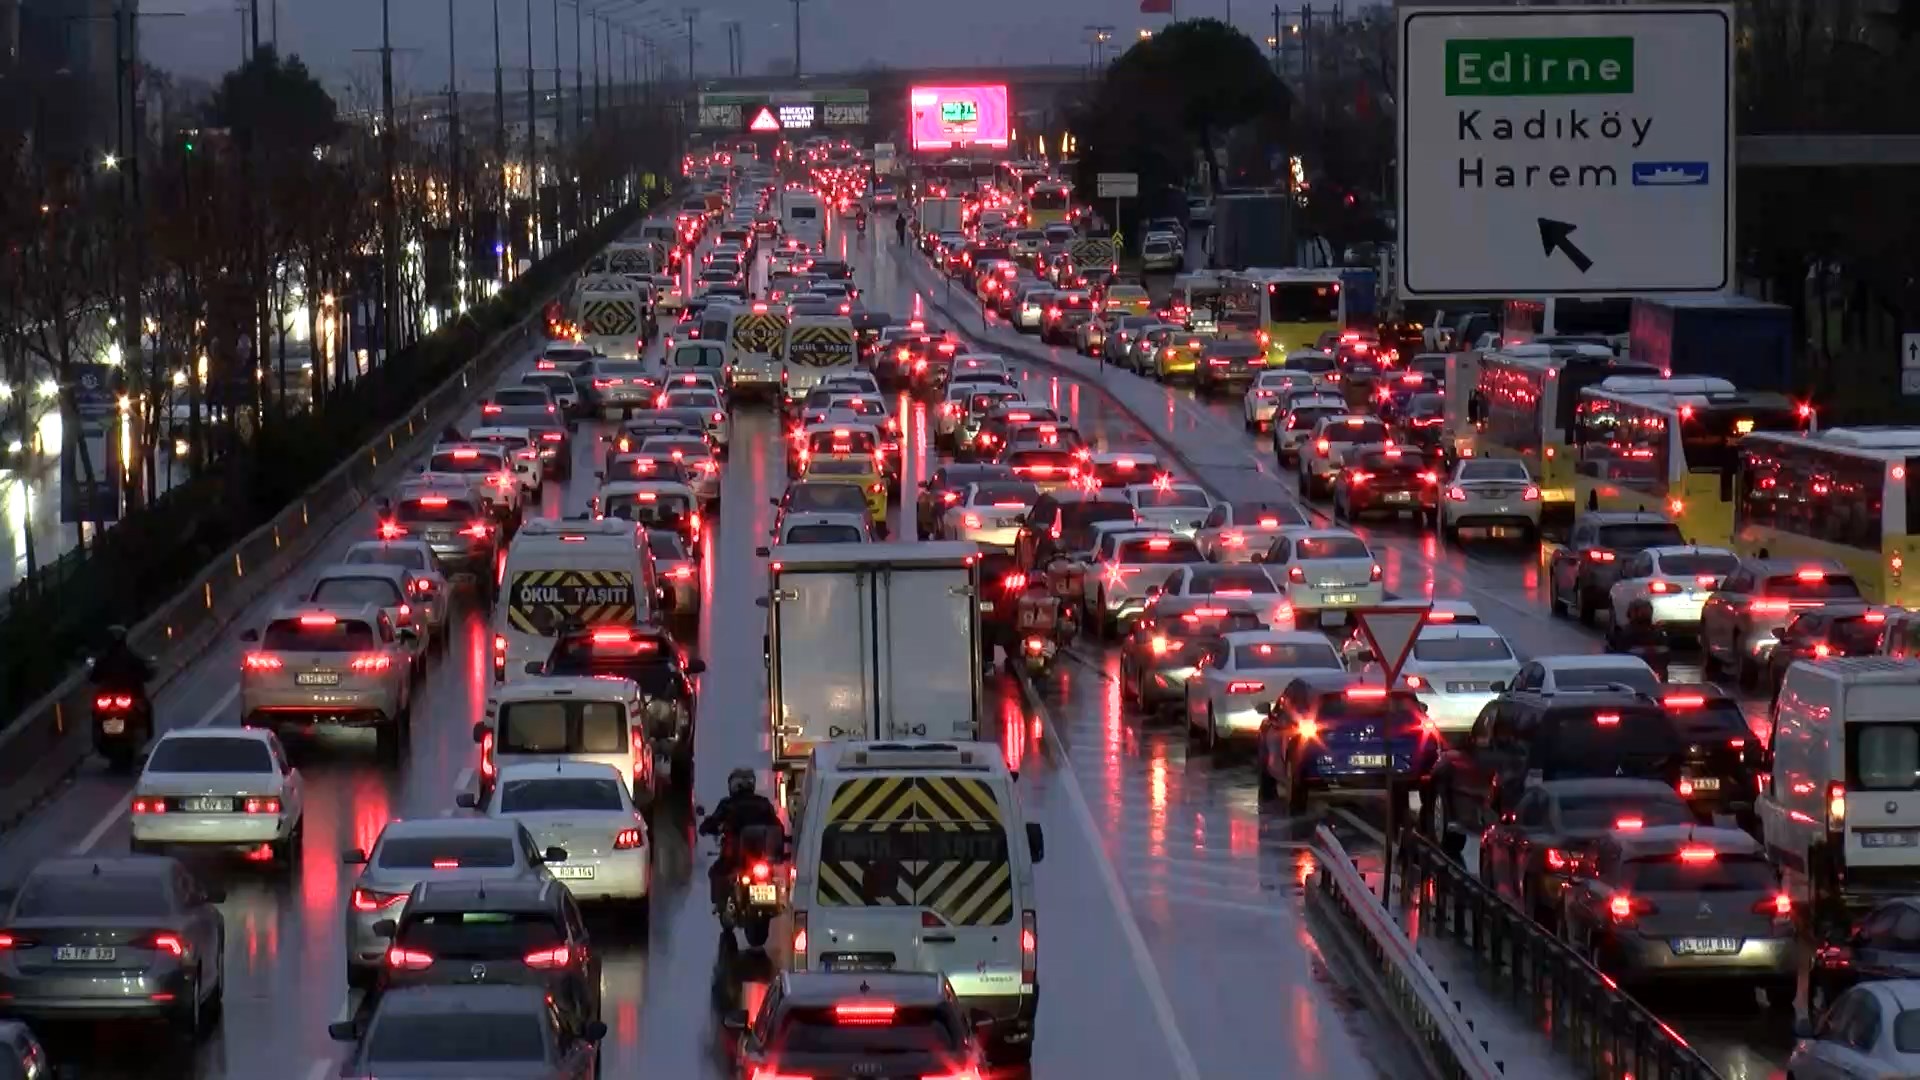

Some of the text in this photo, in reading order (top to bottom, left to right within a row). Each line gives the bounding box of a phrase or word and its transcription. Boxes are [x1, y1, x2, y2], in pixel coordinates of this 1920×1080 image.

[1458, 52, 1621, 85] Edirne
[1459, 109, 1653, 148] Kadıköy
[1459, 158, 1617, 189] Harem
[520, 586, 628, 606] OKUL TAŞITI
